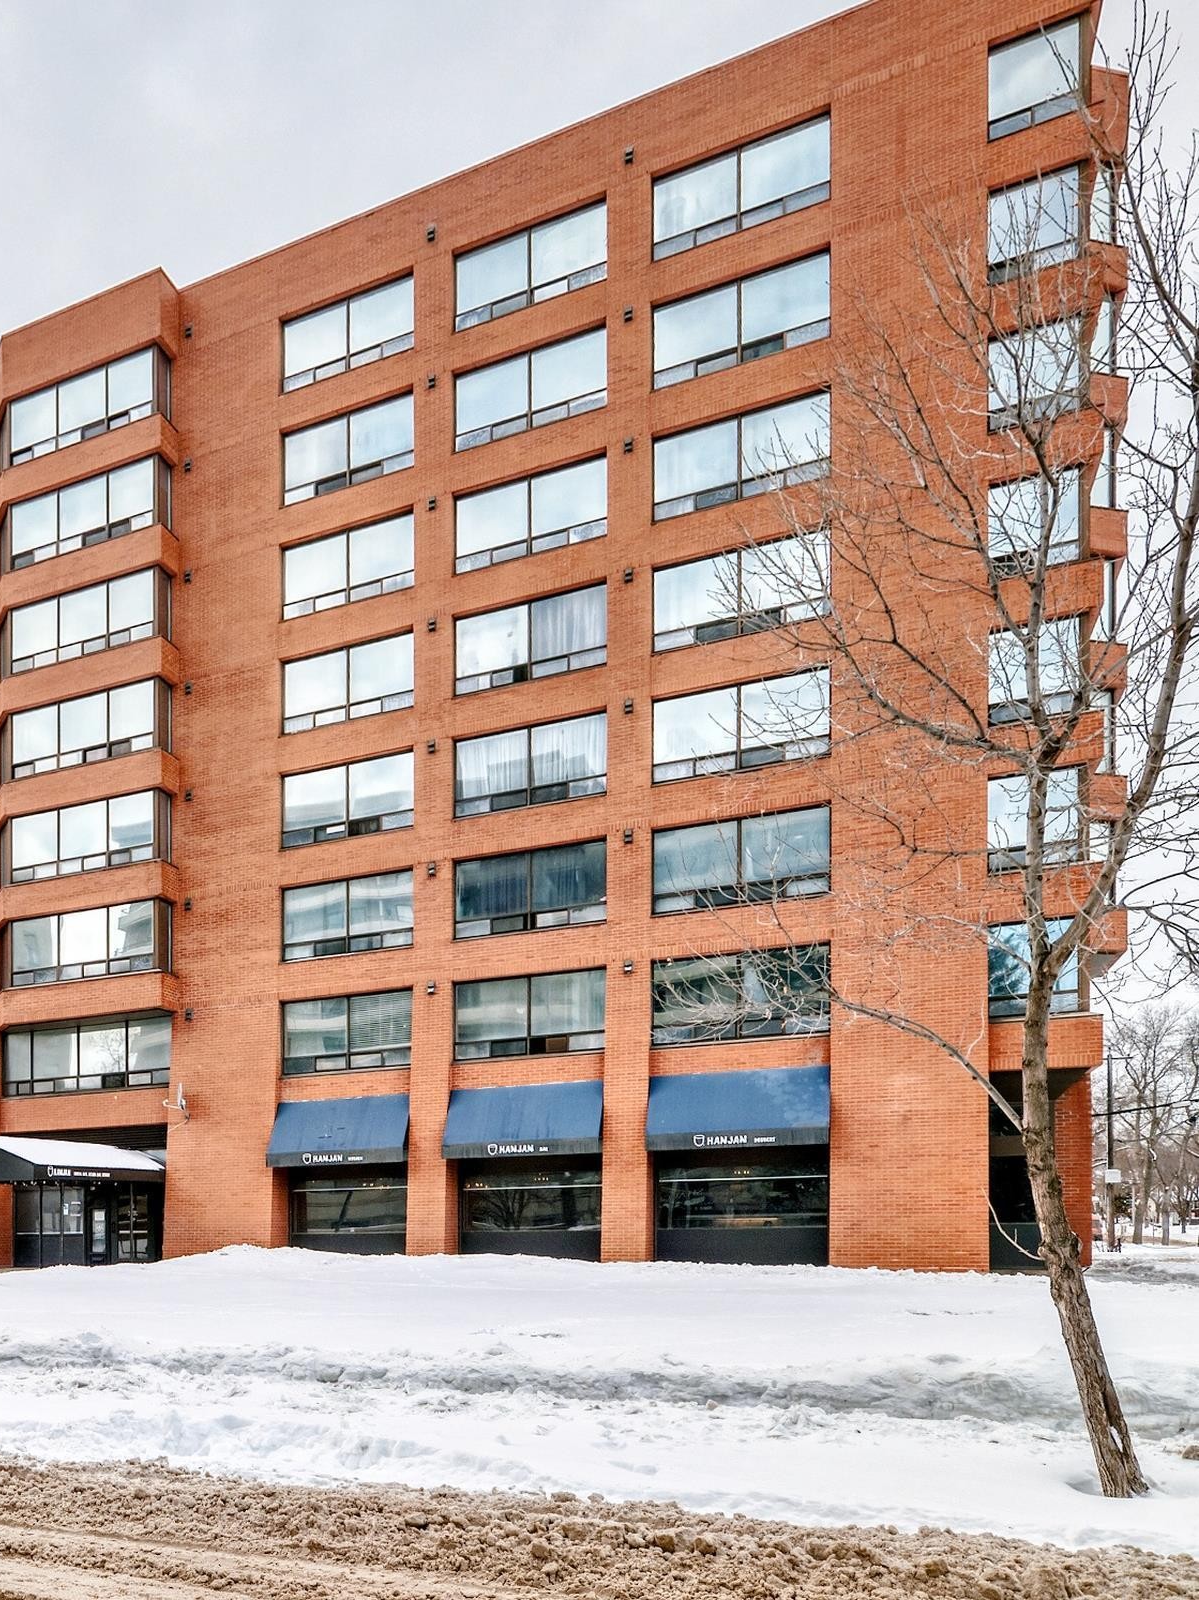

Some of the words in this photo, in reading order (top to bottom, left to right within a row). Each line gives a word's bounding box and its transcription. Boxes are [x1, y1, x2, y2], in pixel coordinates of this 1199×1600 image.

[706, 1134, 747, 1146] HANJAN
[499, 1144, 534, 1154] HANJAN
[312, 1154, 343, 1163] HANJAN
